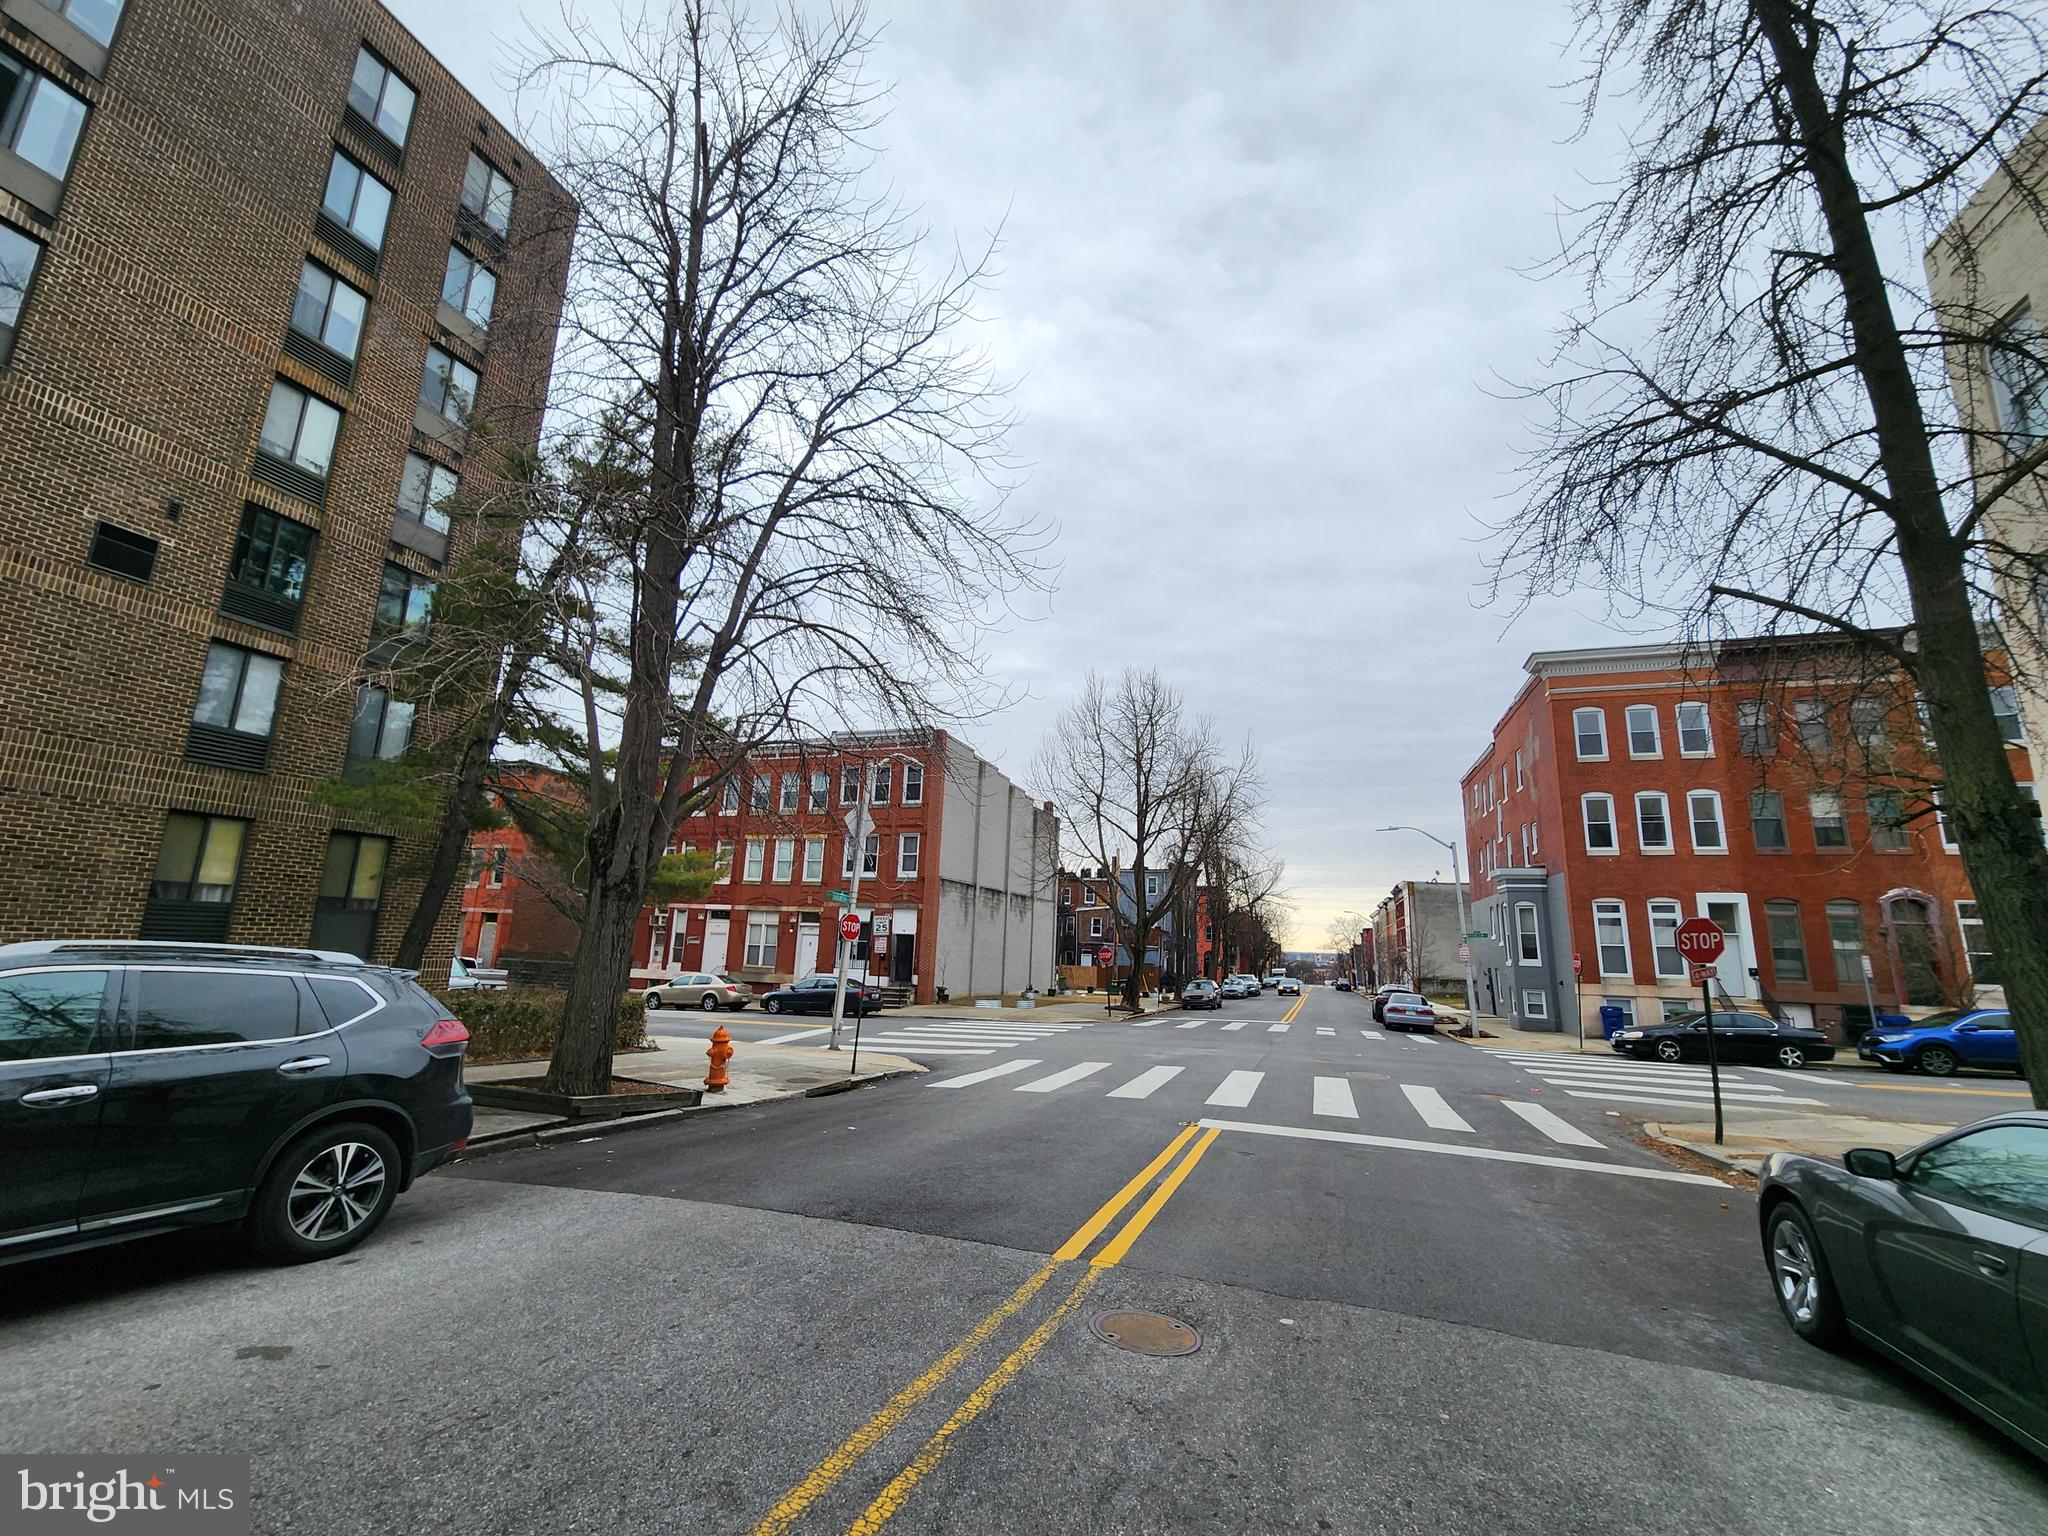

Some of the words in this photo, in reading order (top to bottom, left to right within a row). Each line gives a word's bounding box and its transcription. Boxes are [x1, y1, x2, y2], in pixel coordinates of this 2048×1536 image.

[842, 921, 860, 932] STOP
[875, 924, 888, 932] 25
[1681, 932, 1720, 950] STOP
